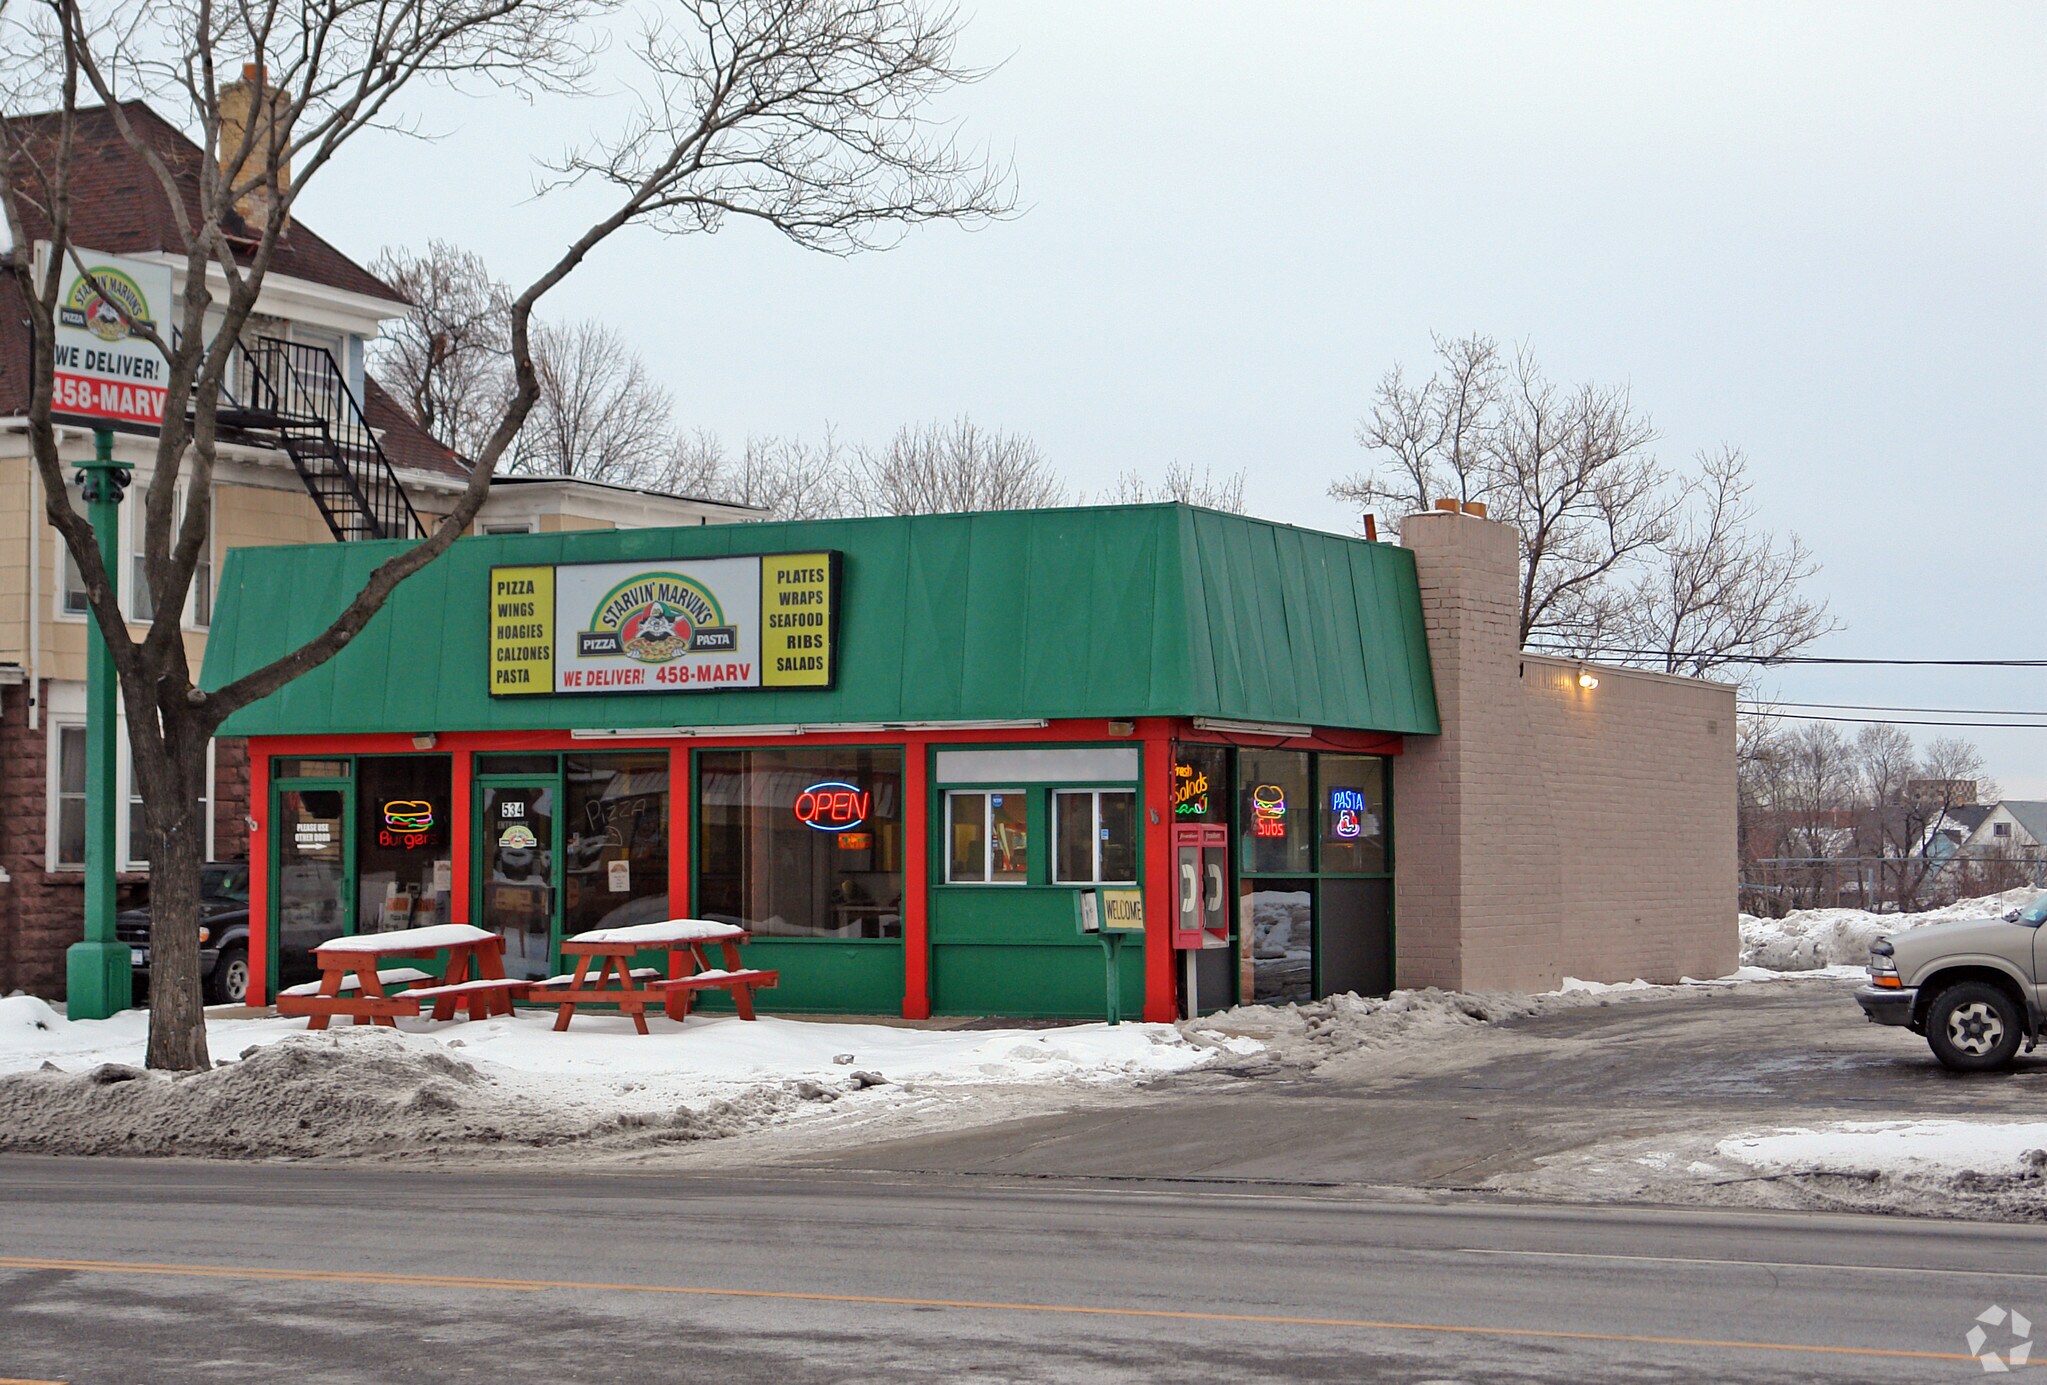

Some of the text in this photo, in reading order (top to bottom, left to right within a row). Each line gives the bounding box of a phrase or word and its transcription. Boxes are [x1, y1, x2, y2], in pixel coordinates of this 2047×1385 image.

[62, 311, 84, 324] PIZZA
[55, 344, 160, 380] WE DELIVER!
[53, 377, 166, 418] 458-MARV
[777, 568, 824, 584] PLATES
[497, 580, 534, 595] PIZZA
[602, 582, 713, 628] STARVIN' MARVIN'S
[779, 591, 823, 606] WRAPS
[498, 602, 534, 617] WINGS
[769, 613, 823, 628] SEAFOOD
[497, 624, 543, 640] HOAGIES
[696, 634, 730, 646] PASTA
[583, 638, 616, 650] PIZZA
[787, 634, 823, 649] RIBS
[497, 645, 549, 661] CALZONES
[777, 656, 823, 671] SALADS
[496, 668, 530, 683] PASTA
[564, 663, 751, 687] WE DELIVER! 458-MARV
[794, 791, 869, 821] OPEN
[1333, 790, 1363, 810] PASTA
[503, 803, 522, 816] 534
[1257, 818, 1285, 836] Subs
[379, 830, 439, 849] Burgers
[1105, 899, 1142, 920] WELCOME
